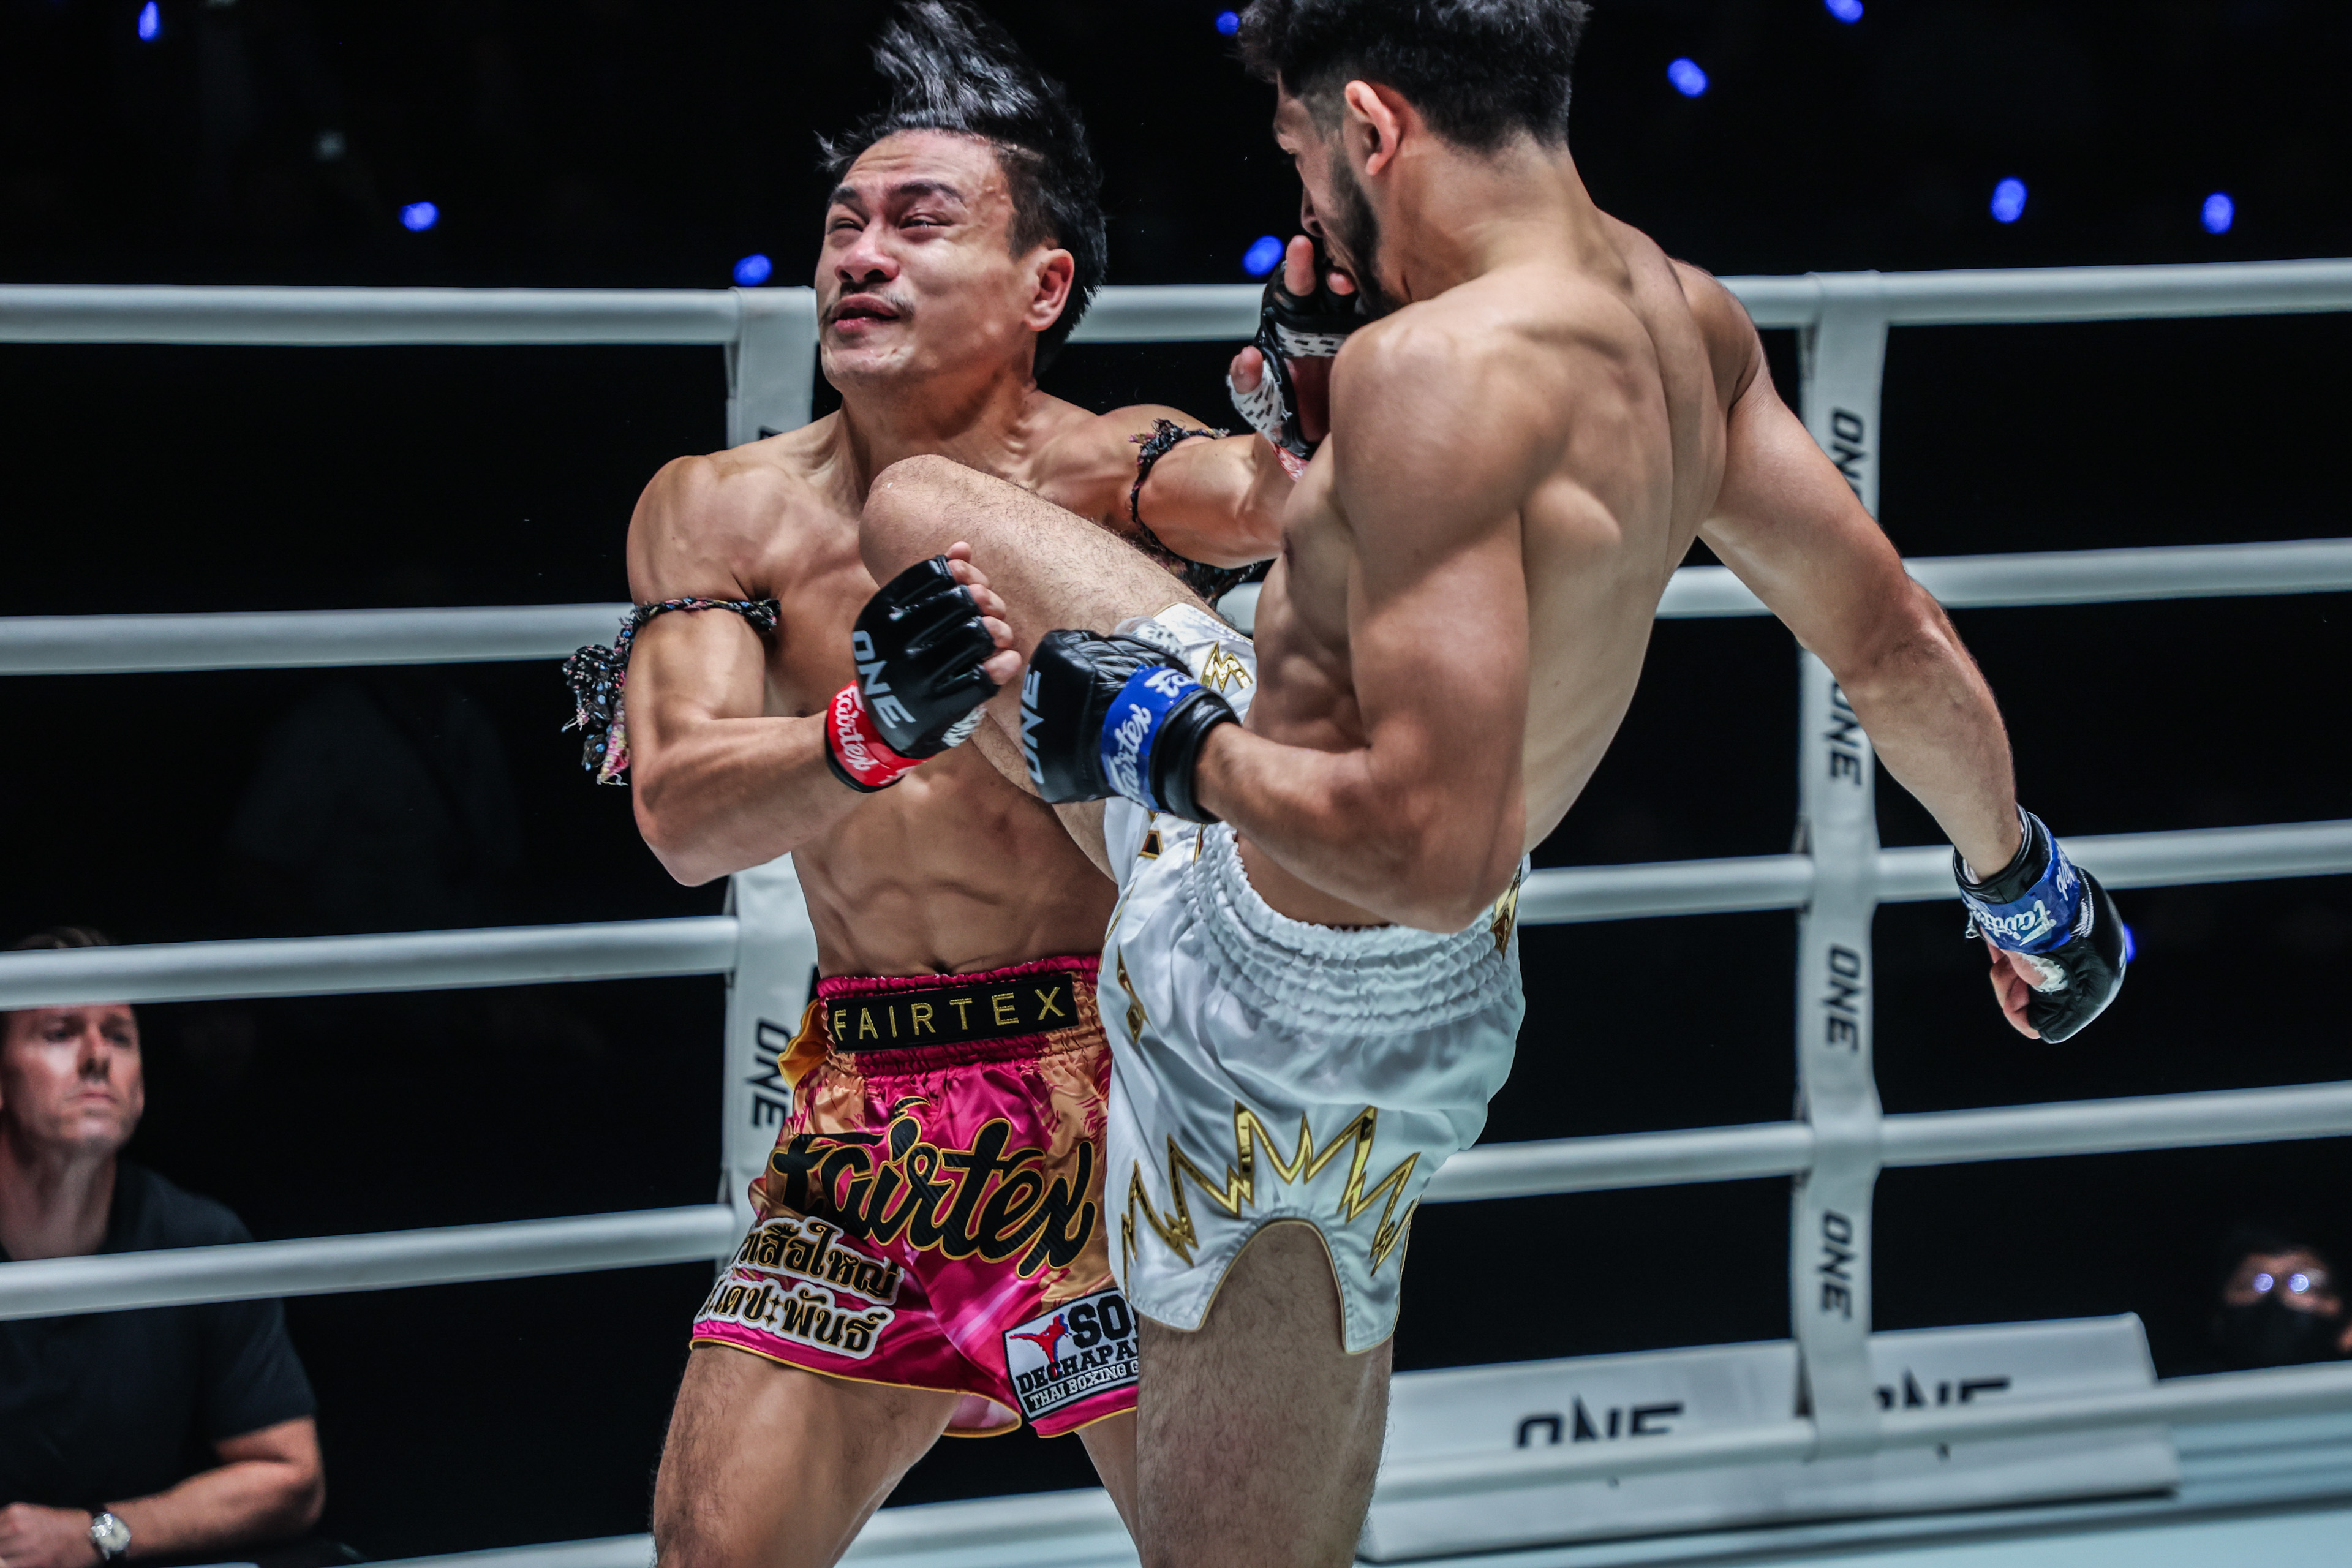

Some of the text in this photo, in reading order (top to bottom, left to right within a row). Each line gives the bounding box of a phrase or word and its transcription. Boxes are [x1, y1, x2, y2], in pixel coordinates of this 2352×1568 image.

[1831, 406, 1867, 503] ON
[853, 631, 917, 729] ONE
[833, 986, 1066, 1041] FAIRTEX
[1822, 943, 1862, 1054] ONE
[744, 1017, 791, 1128] ONE
[1817, 1210, 1855, 1319] ONE
[1016, 1338, 1138, 1395] DECHAPA
[1068, 1294, 1138, 1349] SO
[1029, 1384, 1068, 1409] THAI
[1068, 1364, 1128, 1394] BOXING
